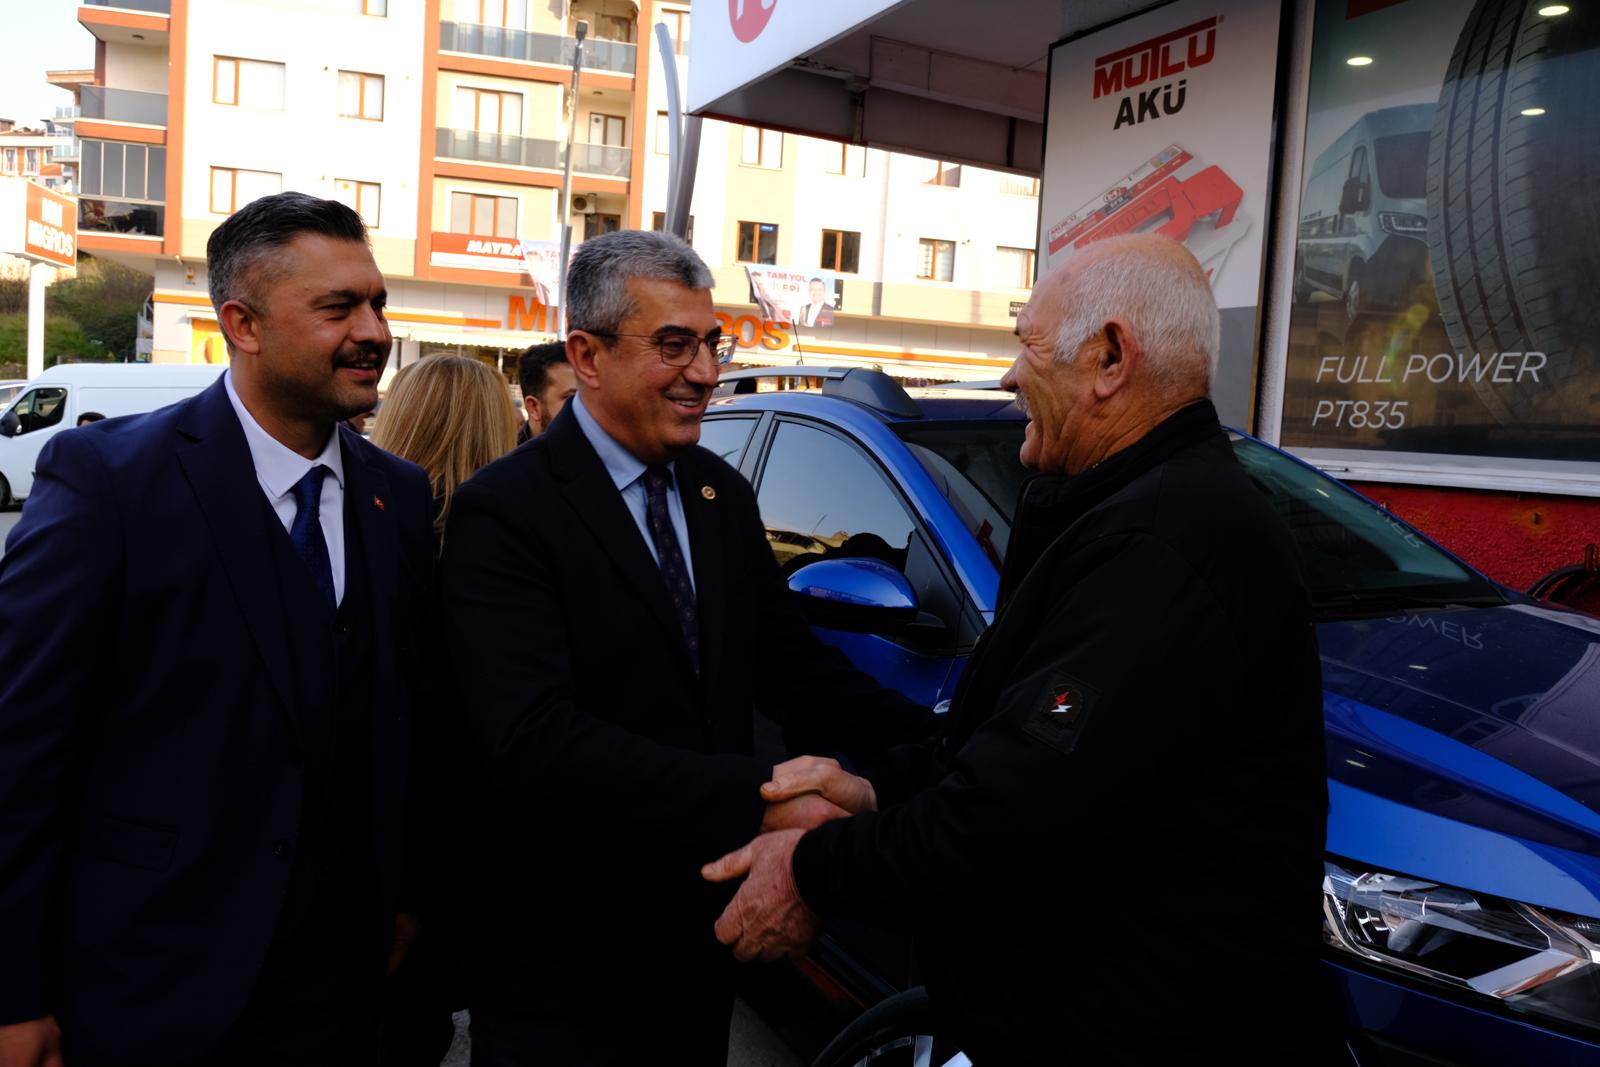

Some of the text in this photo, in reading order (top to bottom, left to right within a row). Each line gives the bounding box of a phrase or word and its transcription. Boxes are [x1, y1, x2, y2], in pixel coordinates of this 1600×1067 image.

[1093, 16, 1217, 99] MUTLU
[1113, 79, 1187, 130] AKÜ
[766, 271, 807, 283] TAM YOL
[1315, 351, 1547, 384] FULL POWER
[1311, 400, 1409, 430] PT835
